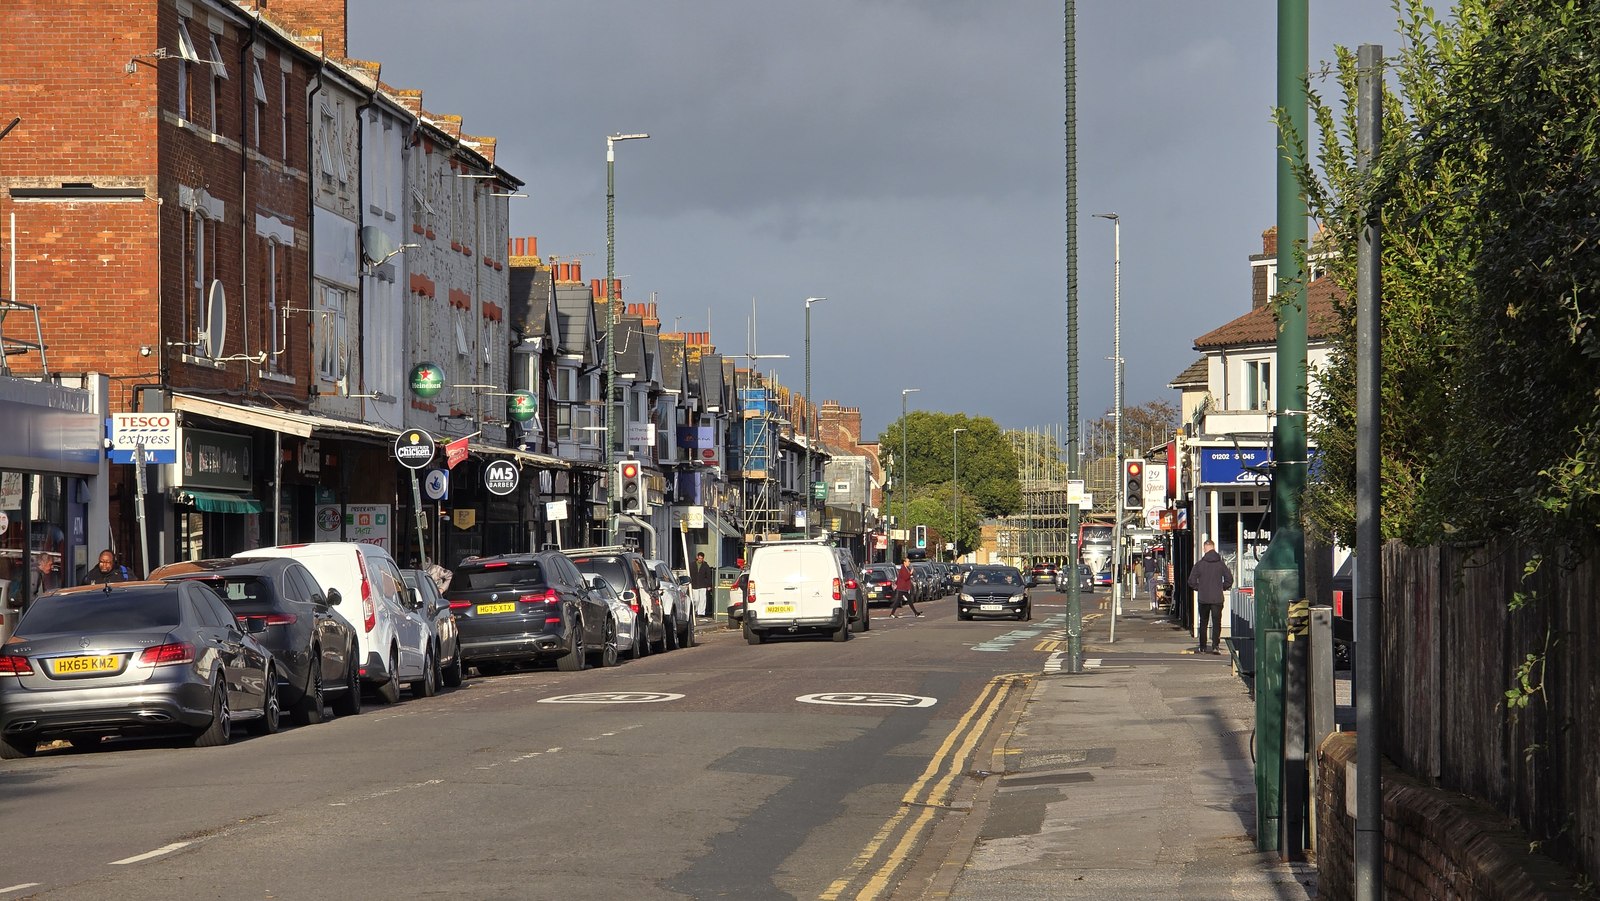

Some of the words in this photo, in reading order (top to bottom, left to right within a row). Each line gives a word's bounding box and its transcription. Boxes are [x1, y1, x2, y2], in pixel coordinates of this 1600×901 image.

[411, 381, 442, 389] Heineken
[118, 416, 170, 428] TESCO
[118, 434, 170, 447] express
[129, 451, 155, 462] AM
[489, 467, 514, 480] M5
[1148, 470, 1160, 479] 29
[74, 516, 84, 535] ATM
[1260, 529, 1271, 541] Day
[480, 605, 498, 613] HG75
[59, 659, 88, 672] HX65
[91, 658, 114, 669] KMZ
